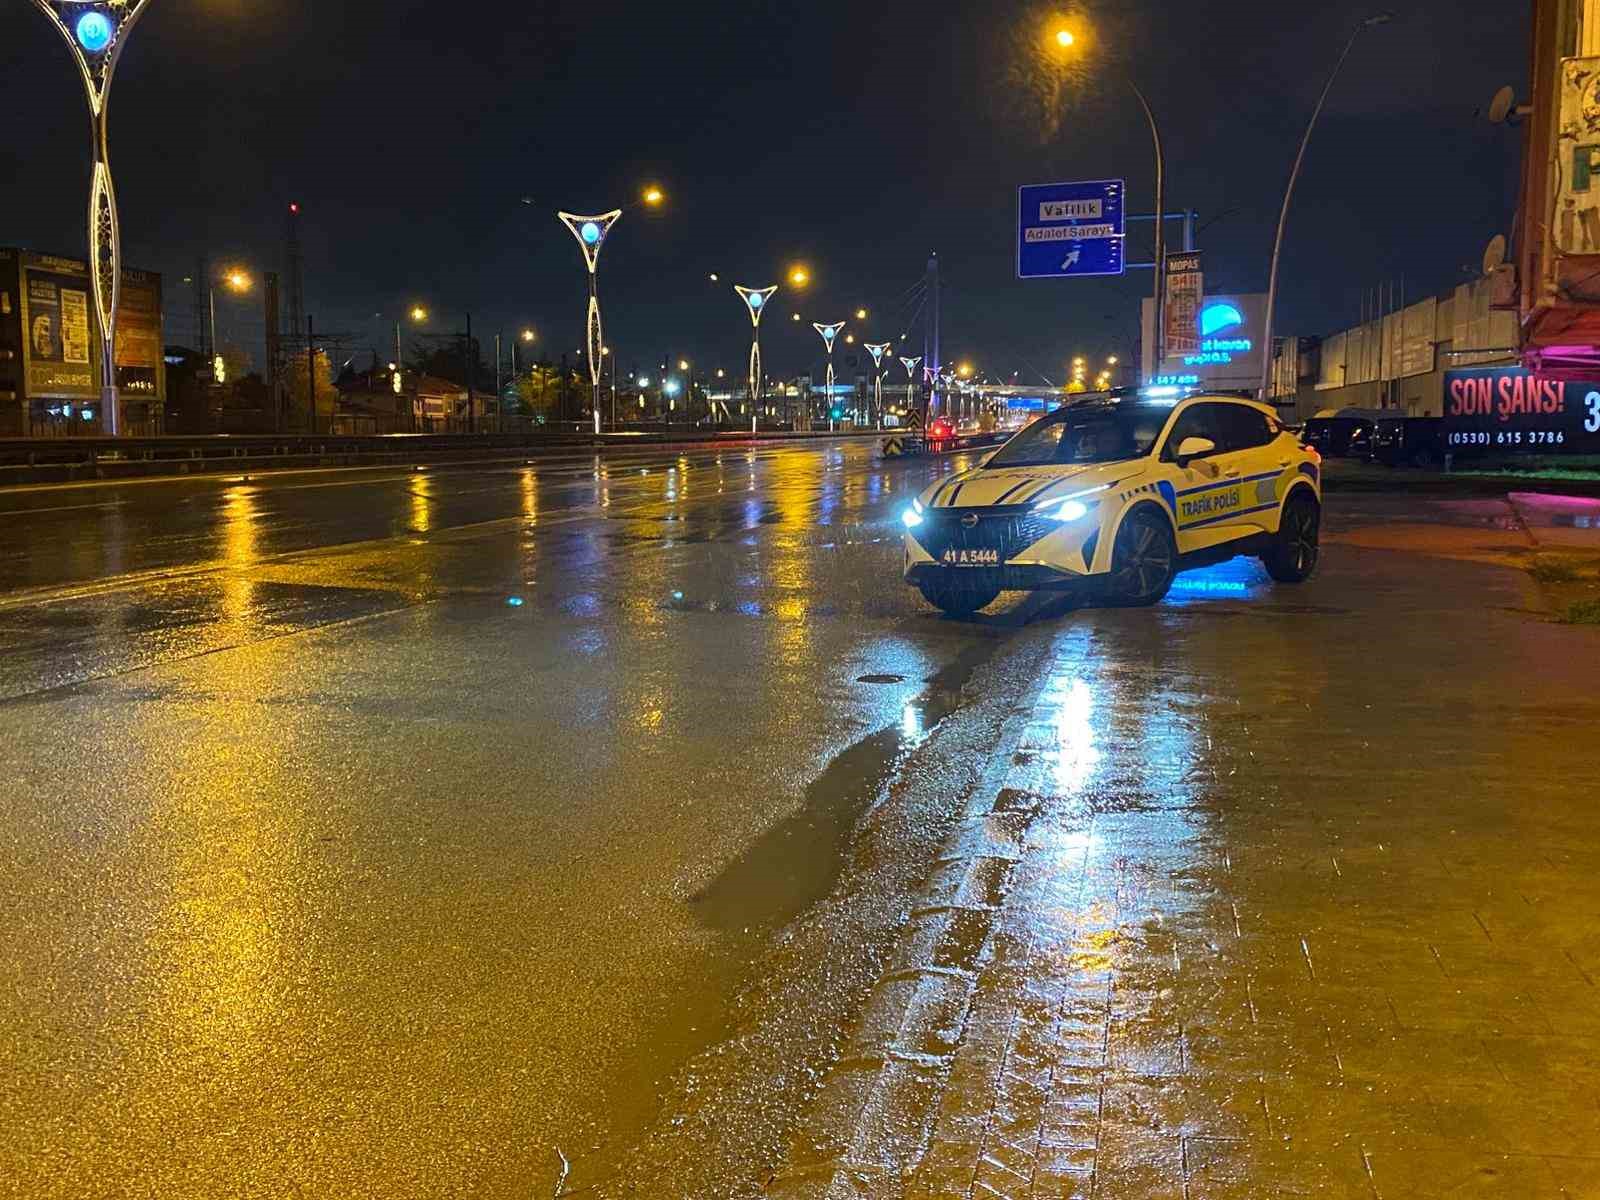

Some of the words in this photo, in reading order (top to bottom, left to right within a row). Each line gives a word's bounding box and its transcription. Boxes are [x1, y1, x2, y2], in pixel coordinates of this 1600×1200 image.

[1044, 202, 1096, 216] Valilik
[1450, 378, 1492, 416] SON
[1498, 375, 1566, 421] ŞANS!
[1449, 432, 1490, 445] (0530)
[1497, 431, 1522, 444] 615
[1528, 431, 1565, 444] 3786
[1181, 496, 1212, 516] TRAFİK
[943, 549, 957, 563] 41
[960, 549, 968, 563] A
[970, 549, 998, 563] 5444
